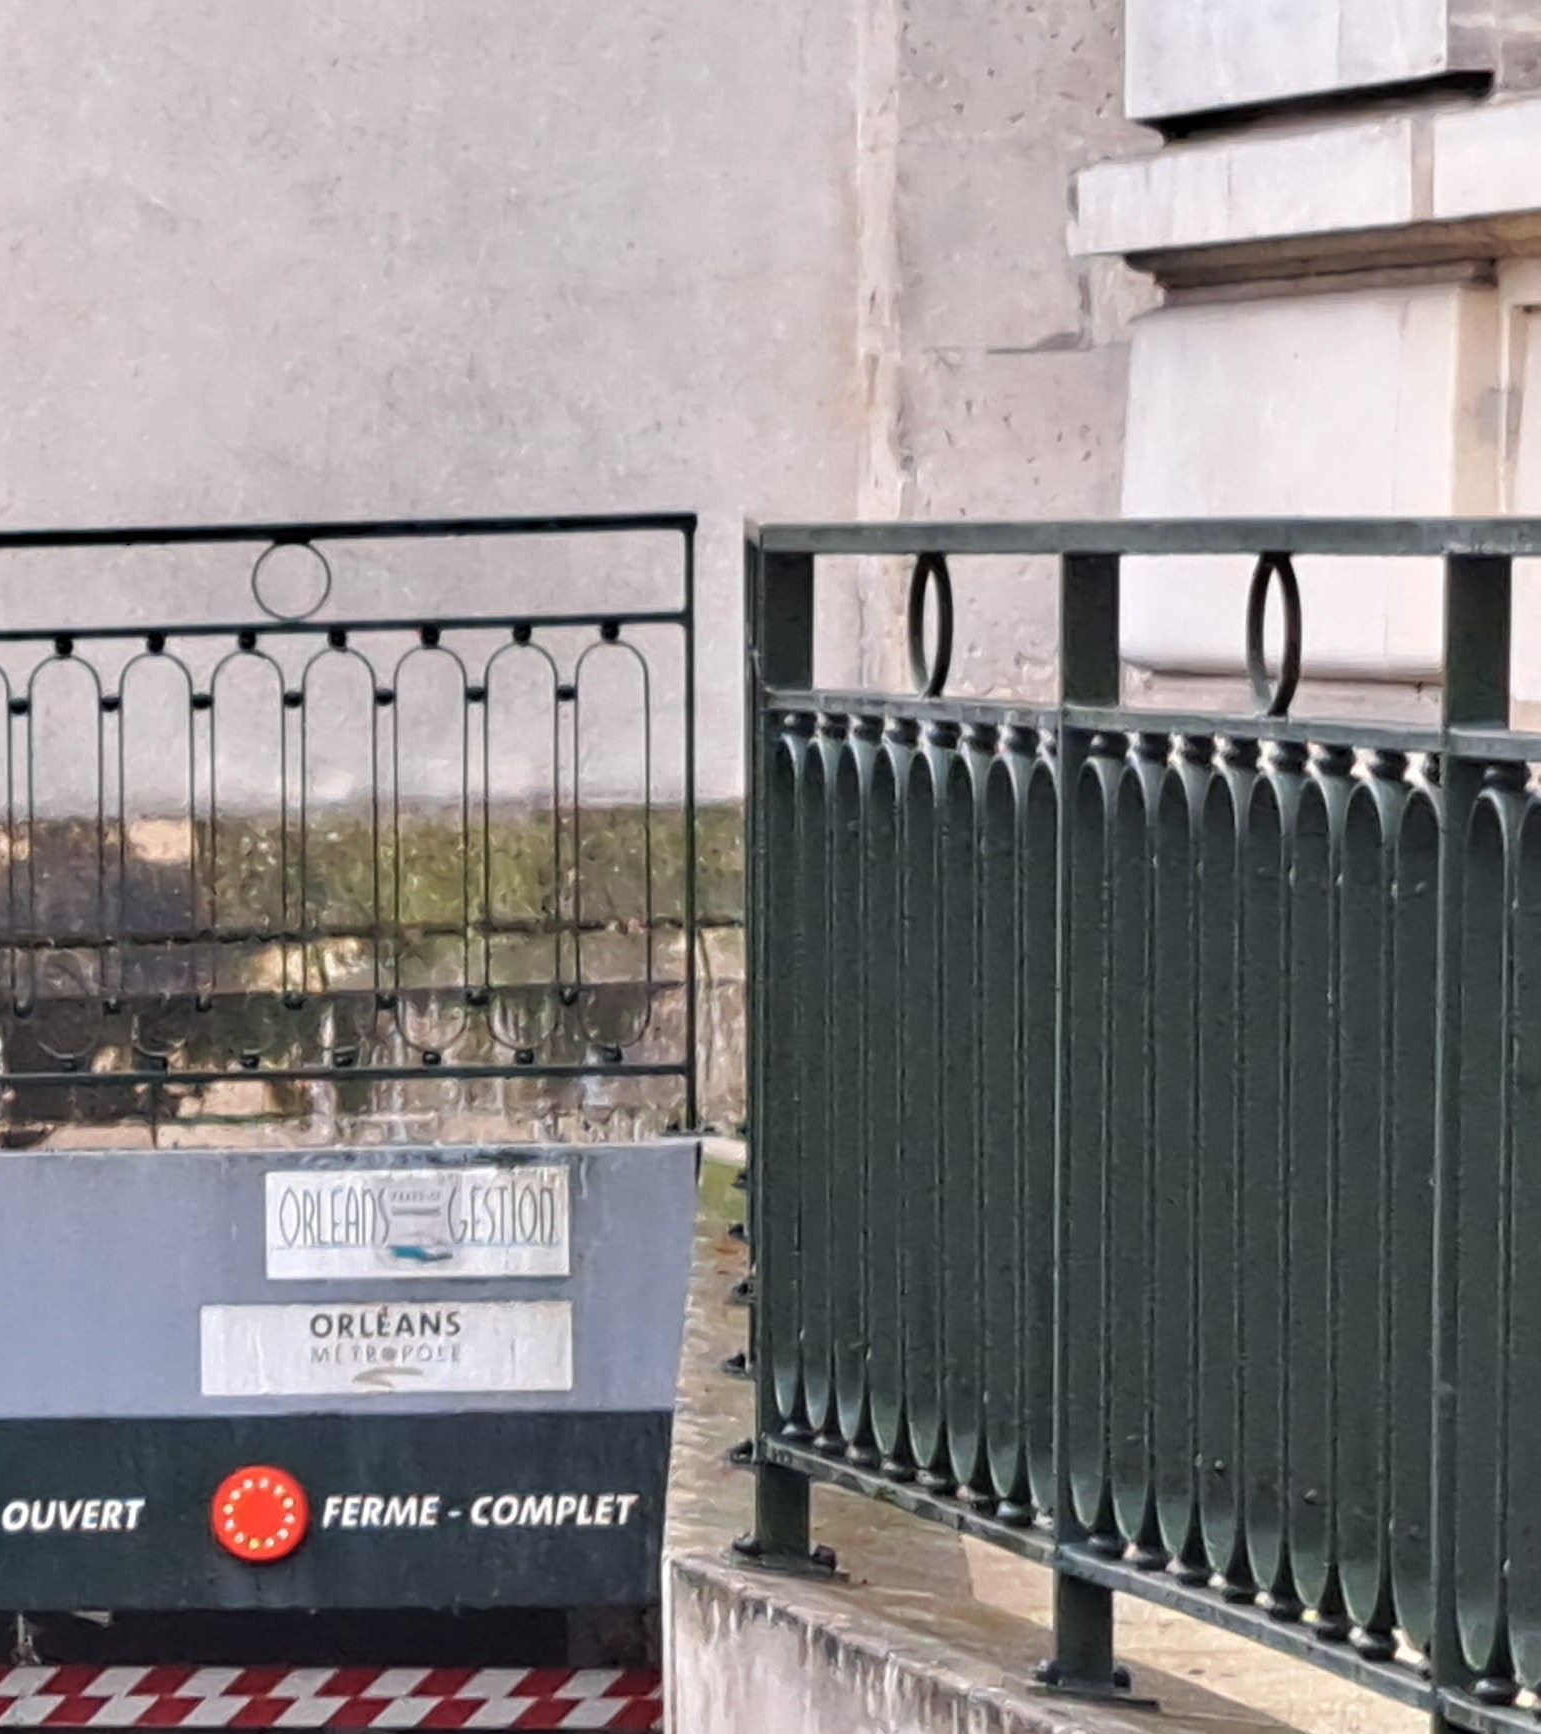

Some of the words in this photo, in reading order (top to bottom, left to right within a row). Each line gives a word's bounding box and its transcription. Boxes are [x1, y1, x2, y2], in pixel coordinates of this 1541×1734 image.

[446, 1181, 556, 1246] GESTION
[1, 1499, 145, 1532] OUVERT
[322, 1495, 441, 1529] FERME
[470, 1493, 639, 1527] COMPLET
